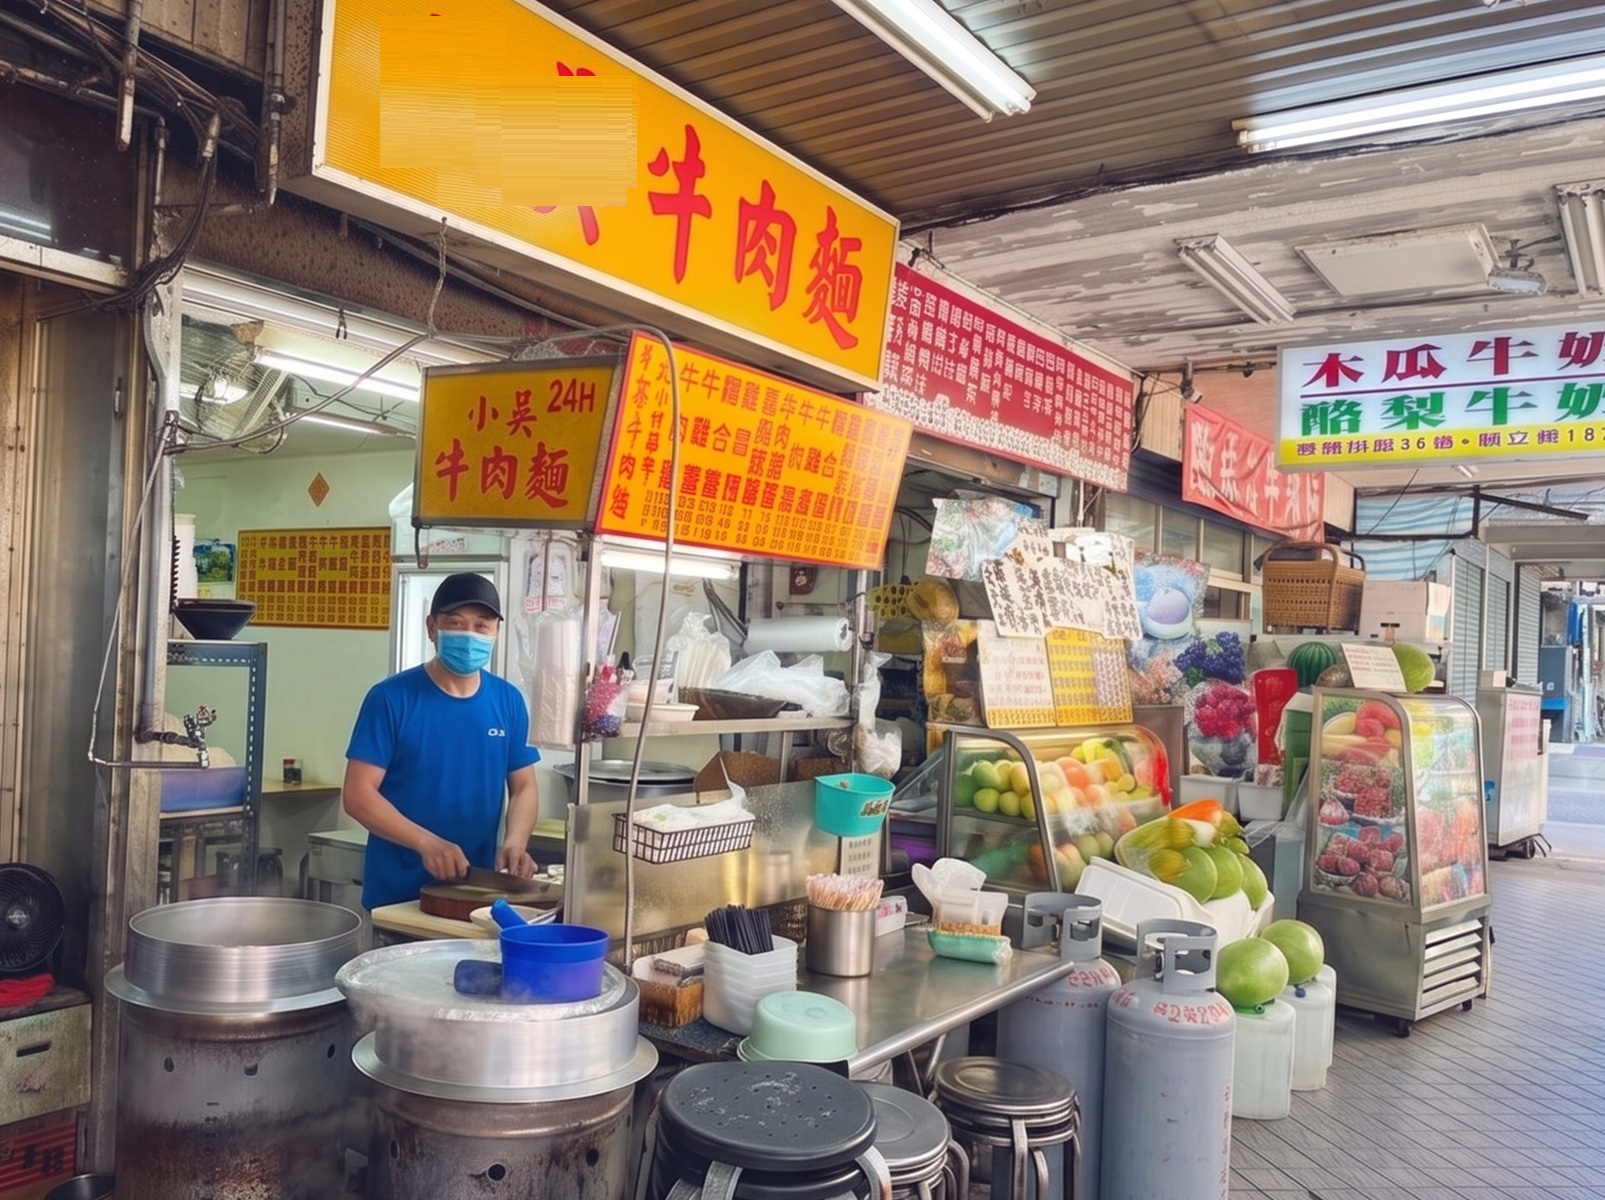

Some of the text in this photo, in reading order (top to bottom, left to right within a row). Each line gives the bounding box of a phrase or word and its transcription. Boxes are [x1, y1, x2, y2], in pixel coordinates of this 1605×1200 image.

[547, 377, 597, 415] 24H
[434, 437, 573, 510] 牛肉麵
